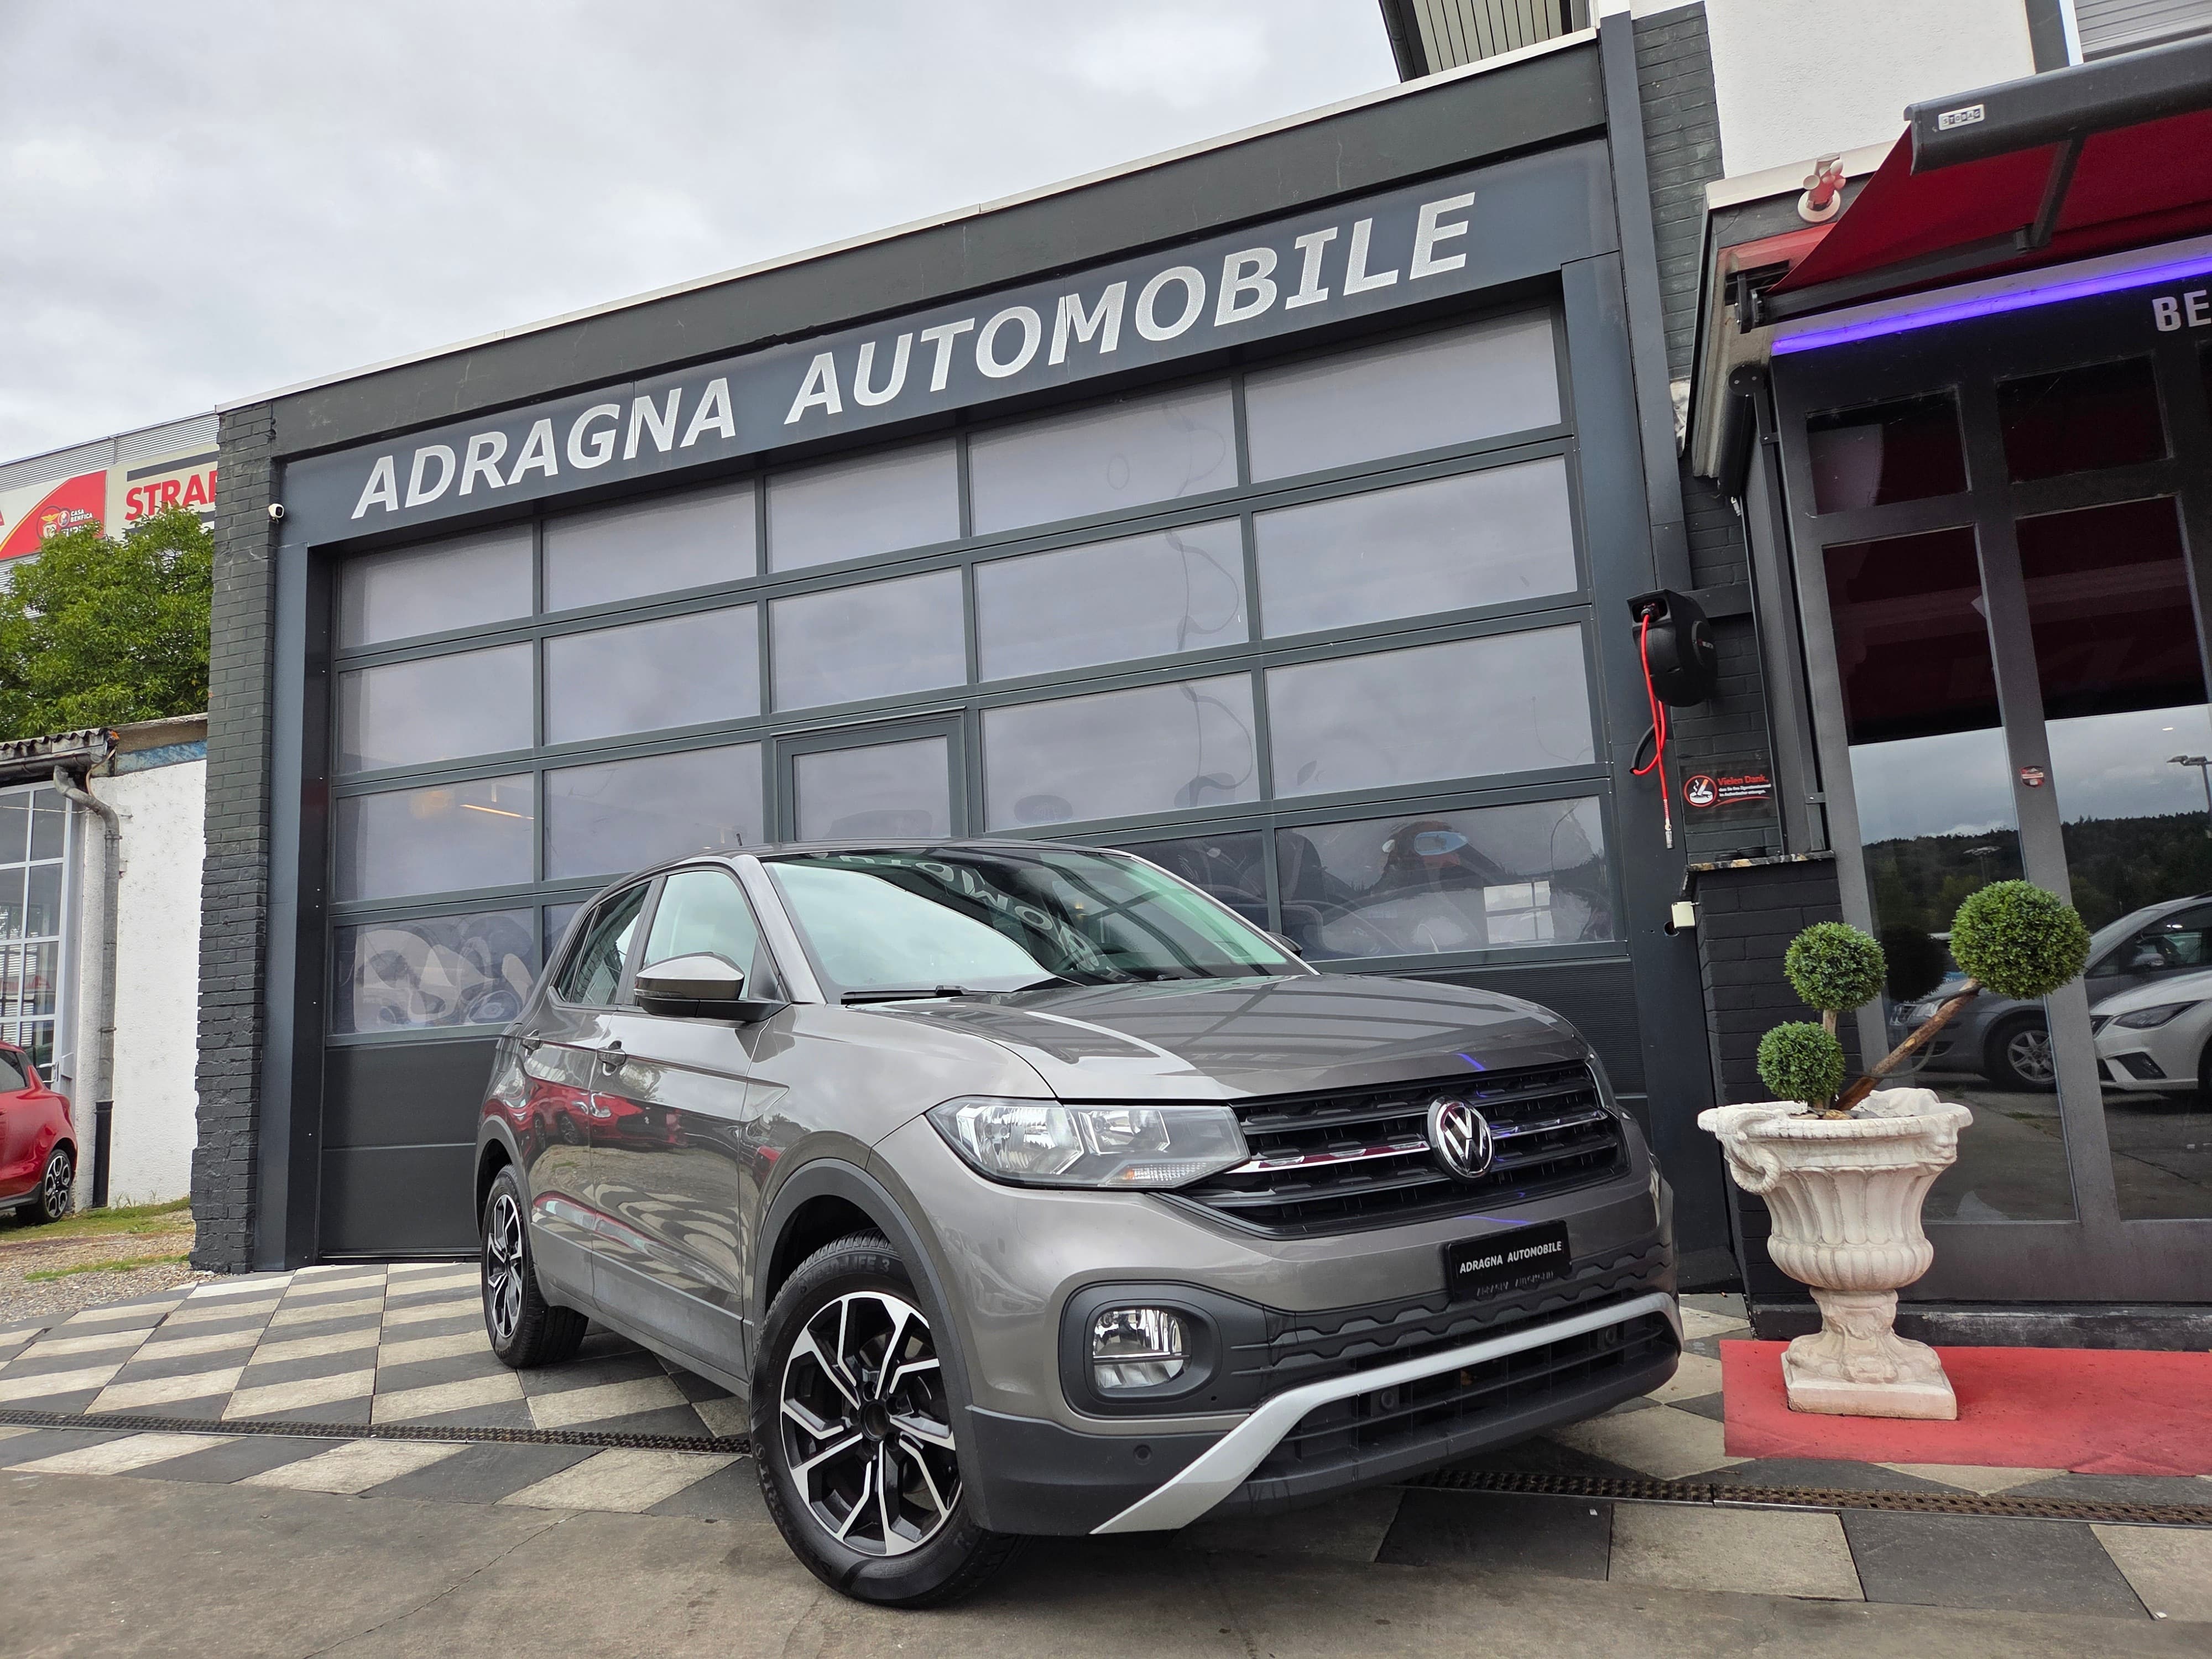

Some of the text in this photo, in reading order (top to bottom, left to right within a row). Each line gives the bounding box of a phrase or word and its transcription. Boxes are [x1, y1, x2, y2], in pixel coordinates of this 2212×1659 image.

[351, 191, 1475, 520] ADRAGNA AUTOMOBILE
[1459, 1254, 1503, 1274] ADRAGNA
